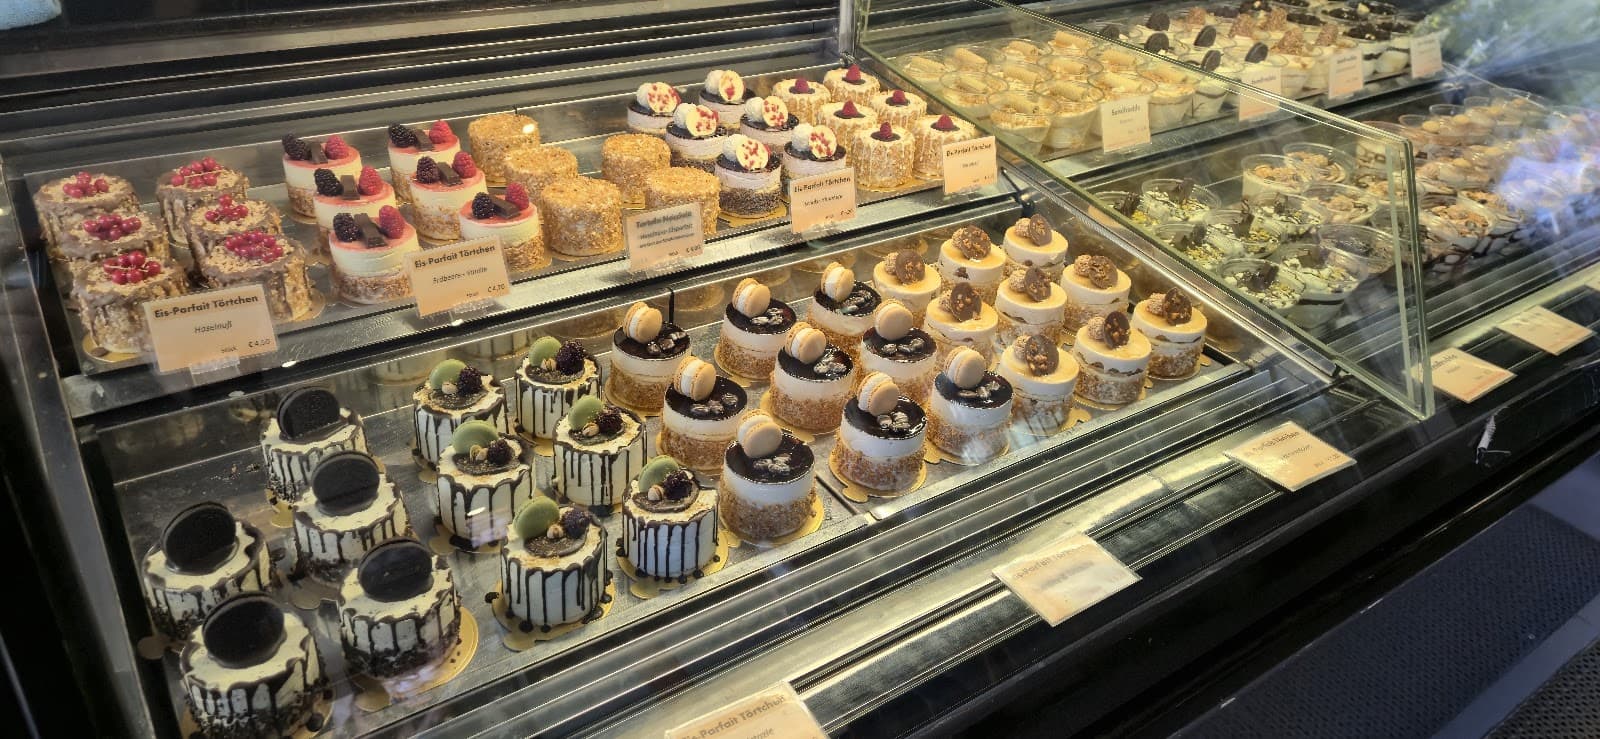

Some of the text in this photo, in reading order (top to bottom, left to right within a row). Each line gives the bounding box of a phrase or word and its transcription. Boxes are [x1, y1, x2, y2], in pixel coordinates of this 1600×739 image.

[414, 244, 496, 269] Eis-Parfait Törtchen
[154, 295, 259, 318] Eis-Parfait Törtchen
[194, 320, 233, 334] Haselnuß
